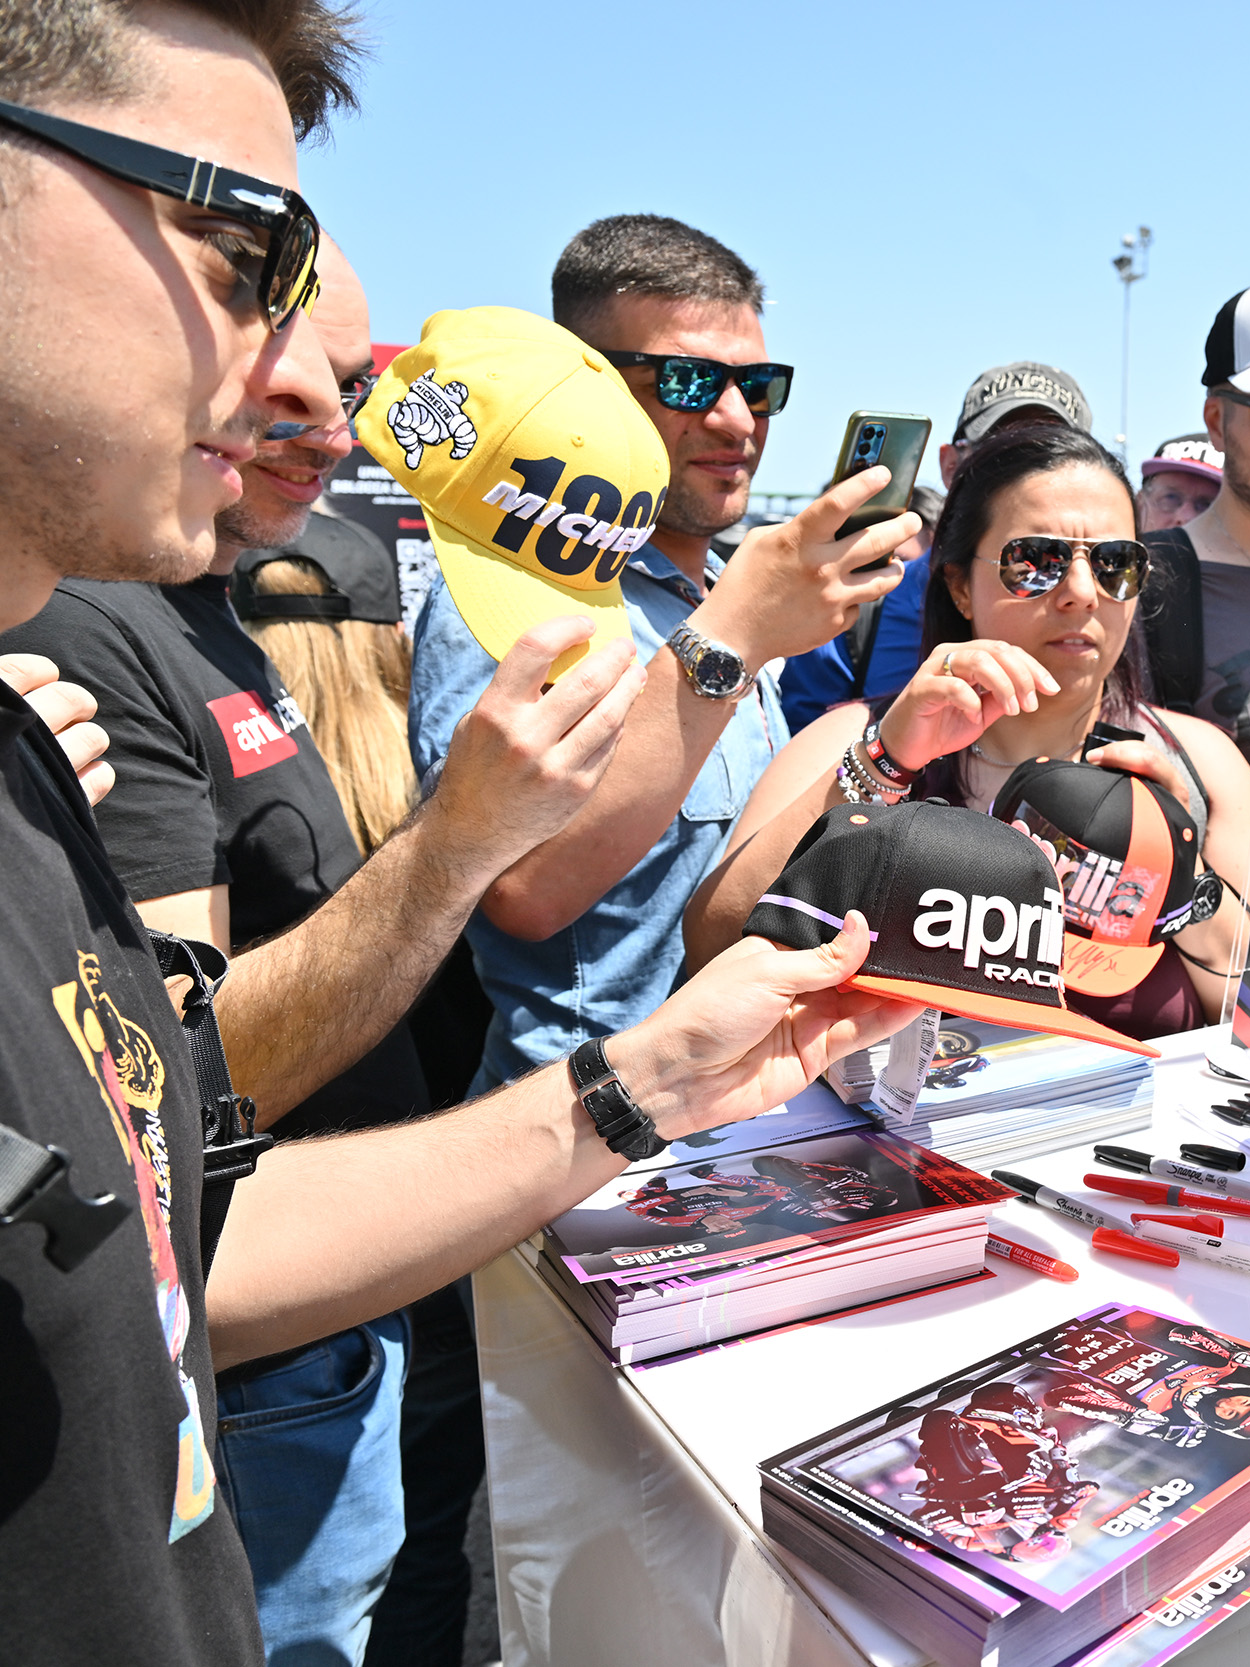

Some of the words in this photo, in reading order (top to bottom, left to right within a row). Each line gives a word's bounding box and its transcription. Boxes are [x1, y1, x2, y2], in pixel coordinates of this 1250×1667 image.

[416, 384, 451, 420] MICHELIN
[879, 759, 902, 778] racer
[612, 1243, 707, 1266] aprilia
[1014, 1247, 1024, 1256] FOR
[1023, 1251, 1033, 1259] ALL
[1032, 1254, 1057, 1269] SURFACES
[1101, 1352, 1169, 1385] aprilia
[1100, 1479, 1195, 1538] aprilia
[1154, 1566, 1246, 1628] aprilia
